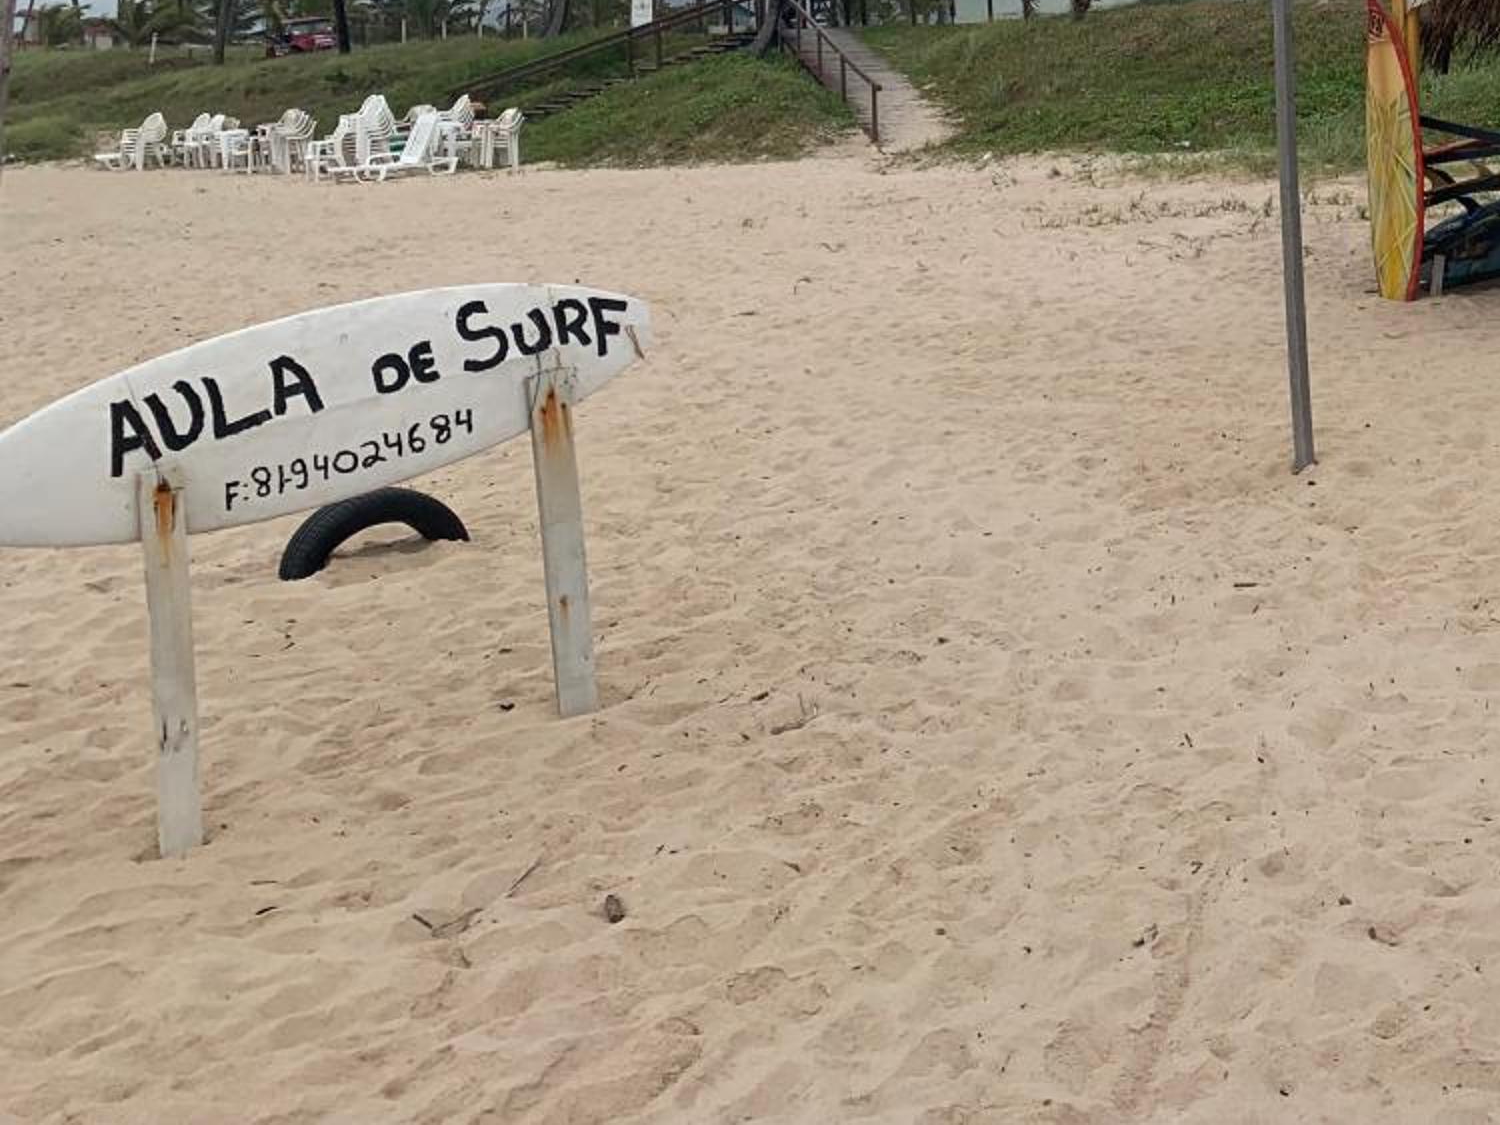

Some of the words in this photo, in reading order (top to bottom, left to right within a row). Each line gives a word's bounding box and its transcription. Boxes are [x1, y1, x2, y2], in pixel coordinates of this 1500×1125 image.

[109, 355, 325, 477] AULA
[371, 341, 440, 395] DE
[455, 299, 627, 371] SURF
